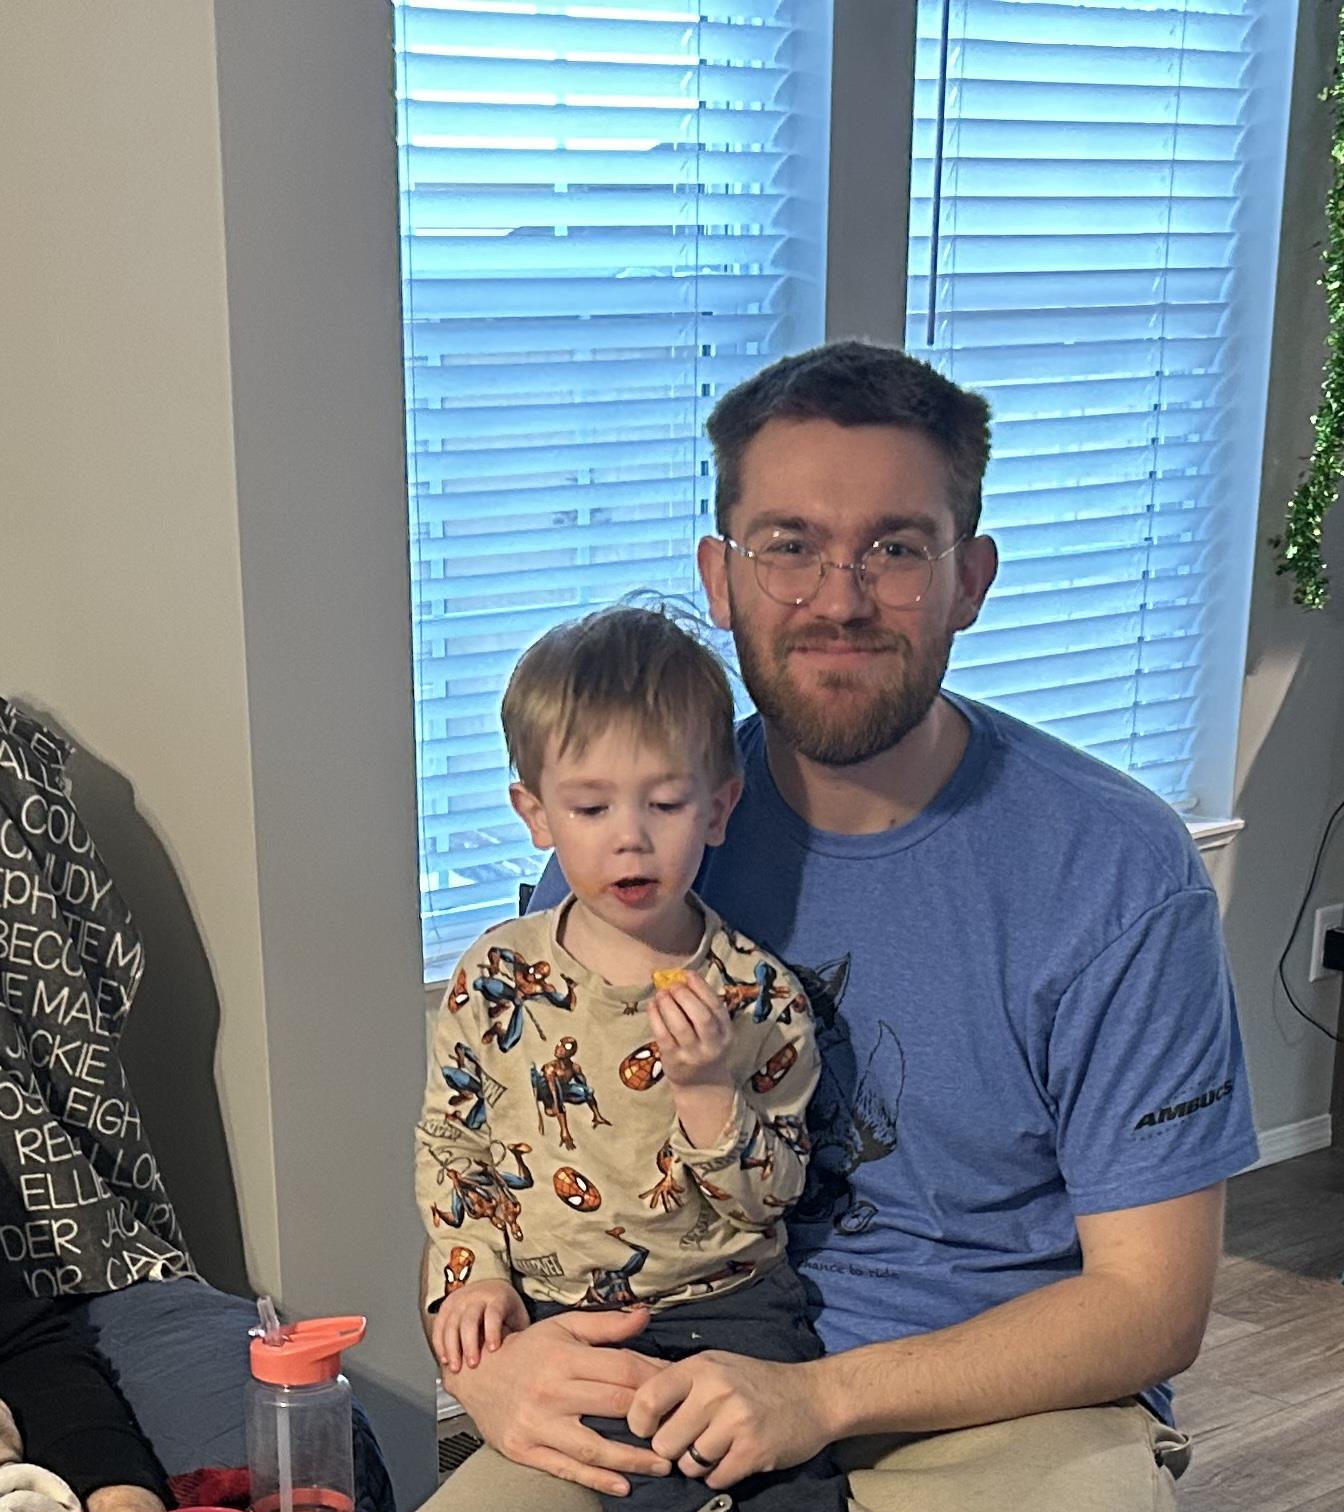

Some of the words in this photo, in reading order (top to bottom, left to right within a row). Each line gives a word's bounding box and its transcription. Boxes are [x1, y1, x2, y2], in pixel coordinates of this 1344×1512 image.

[22, 795, 95, 858] COU
[62, 911, 106, 963] TIE
[63, 1086, 142, 1141] EIGH
[102, 1202, 140, 1247] JAC
[22, 1264, 83, 1298] OR
